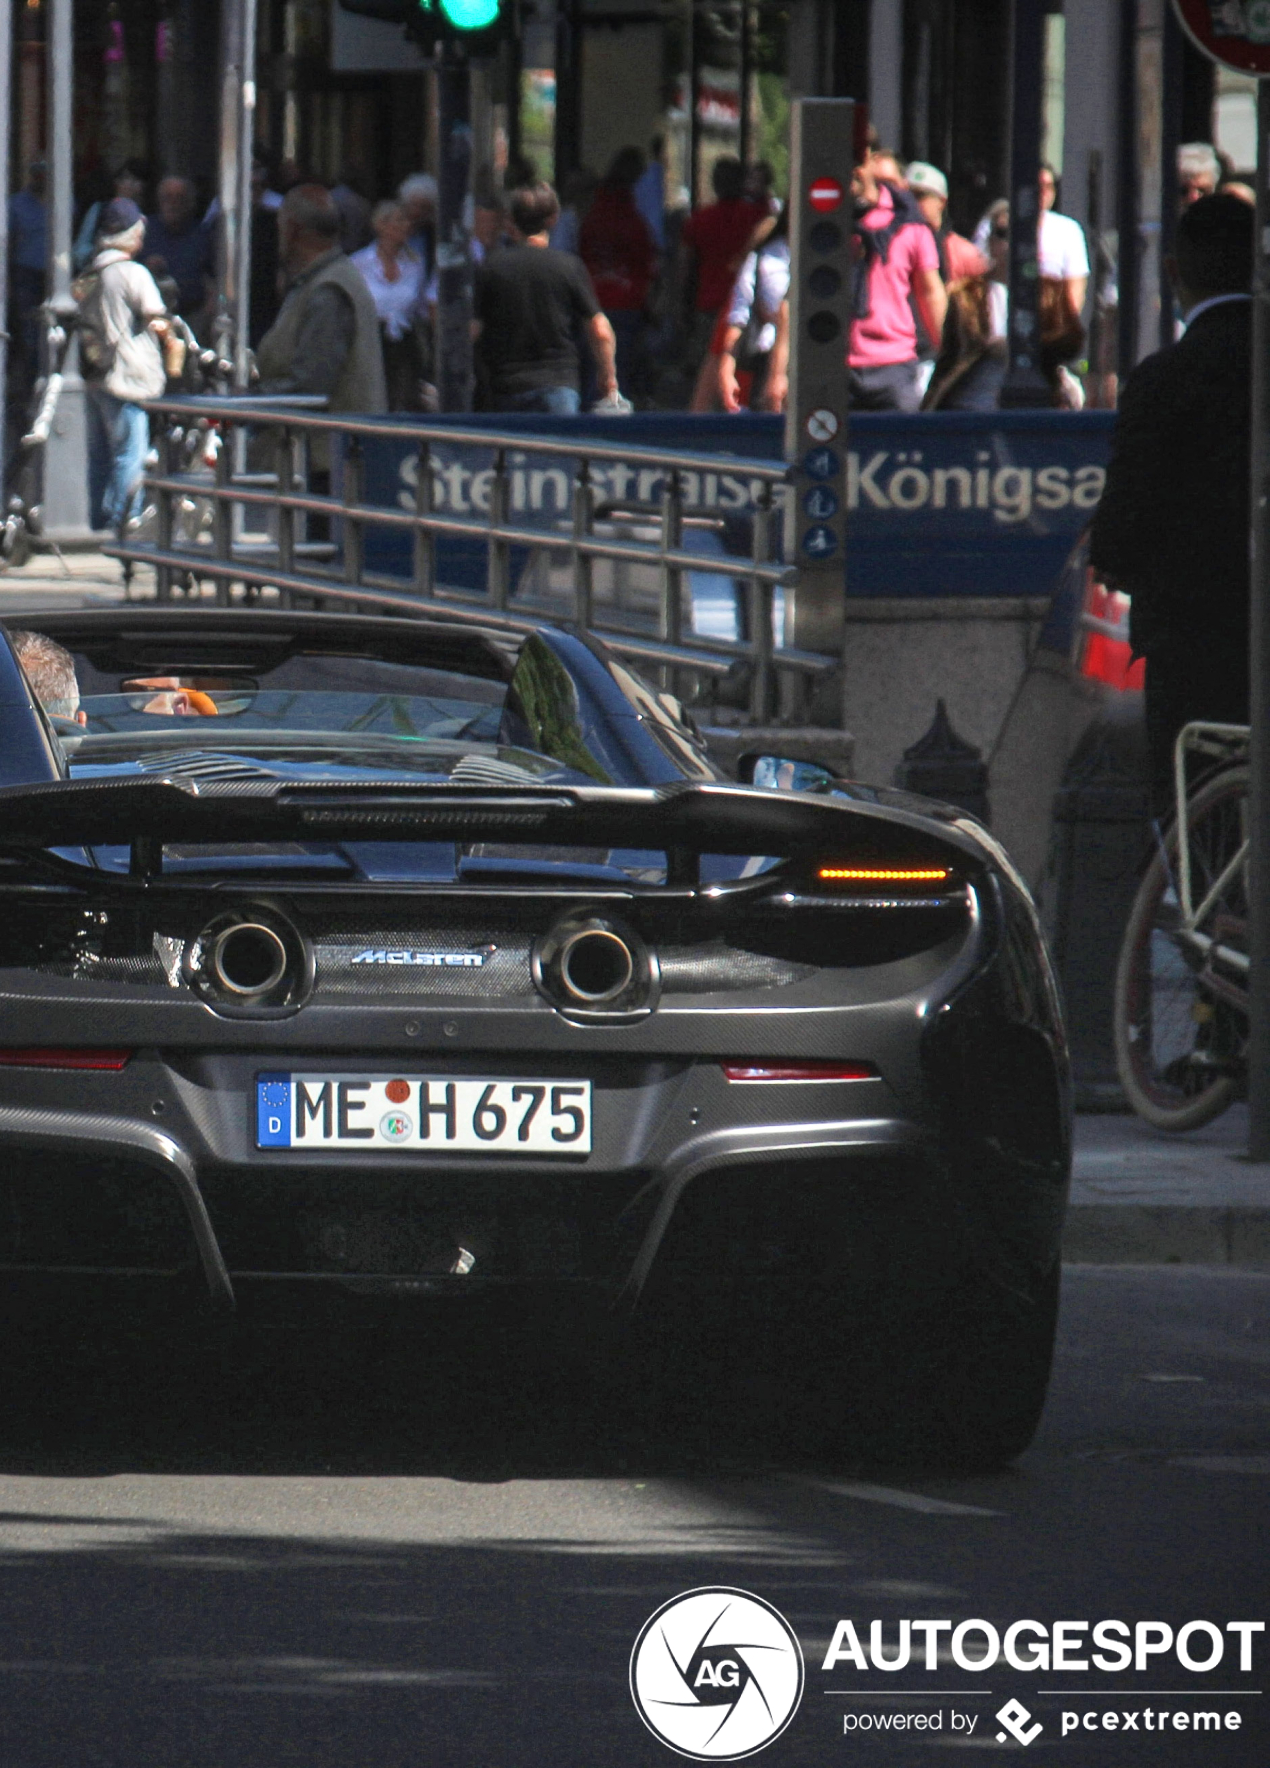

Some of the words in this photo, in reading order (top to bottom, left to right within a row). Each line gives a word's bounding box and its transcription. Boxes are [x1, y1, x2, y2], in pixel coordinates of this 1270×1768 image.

[351, 950, 483, 967] McLaren
[268, 1117, 281, 1134] D
[295, 1081, 375, 1140] ME
[419, 1081, 456, 1140] H
[472, 1084, 586, 1143] 675
